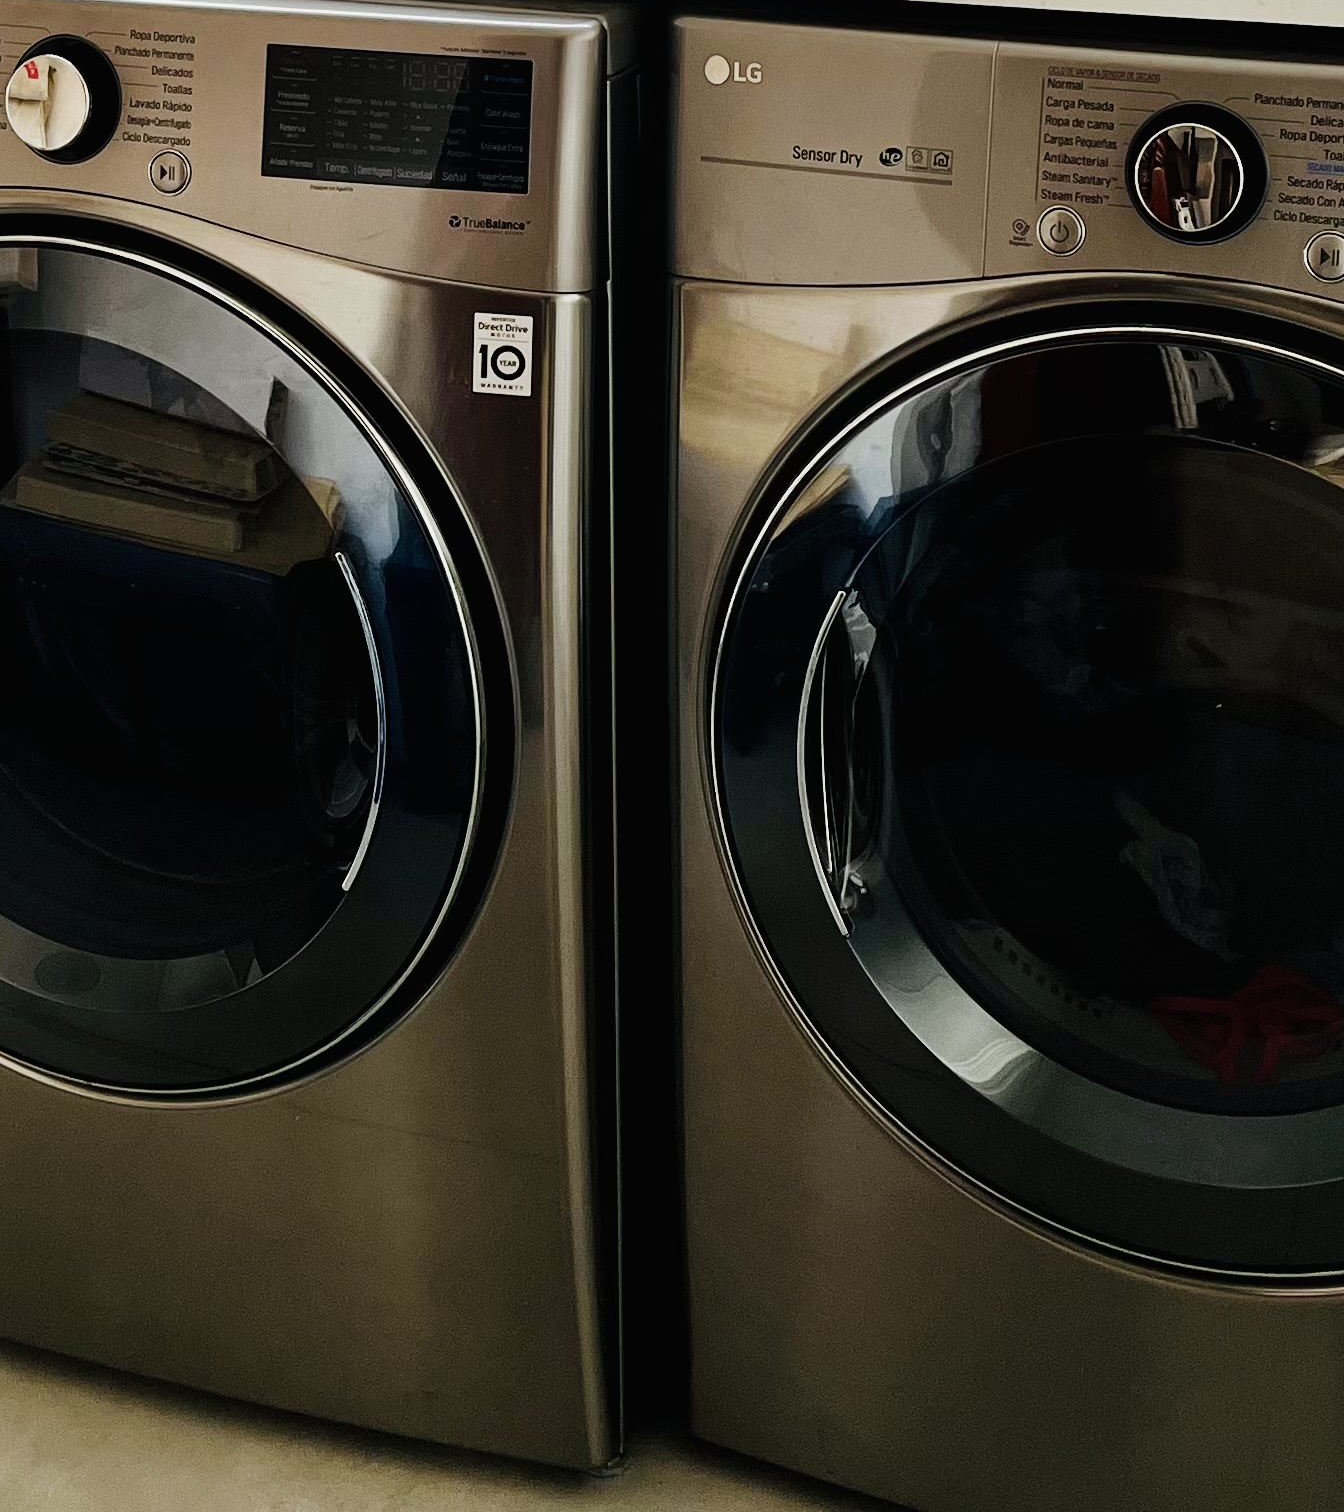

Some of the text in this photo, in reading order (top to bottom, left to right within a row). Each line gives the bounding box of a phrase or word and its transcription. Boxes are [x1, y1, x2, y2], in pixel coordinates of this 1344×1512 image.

[129, 29, 196, 45] Ropa Deportiva
[114, 45, 195, 61] Planchado Permanente
[151, 65, 194, 79] Delicados
[732, 61, 763, 85] LG
[162, 83, 193, 96] Toallas
[1047, 77, 1084, 91] Normal
[129, 98, 193, 113] Lavado Rápido
[1045, 96, 1115, 112] Carga Pesada
[1254, 93, 1304, 108] Planchado
[1044, 114, 1115, 131] Ropa de cama
[122, 131, 191, 148] Ciclo Descargado
[1043, 132, 1118, 150] Cargas Pequeñas
[1279, 128, 1307, 143] Ropa
[792, 145, 863, 168] Sensor Dry
[1043, 151, 1109, 167] Antibacterial
[1041, 169, 1071, 183] Steam
[1286, 175, 1324, 190] Secado
[1040, 188, 1073, 202] Steam
[1277, 192, 1315, 206] Secado
[1316, 195, 1337, 208] Con
[462, 216, 526, 231] TrueBalance
[1273, 209, 1298, 223] Ciclo
[478, 321, 529, 334] Direct Drive
[478, 344, 526, 381] 10
[499, 359, 517, 367] YEAR
